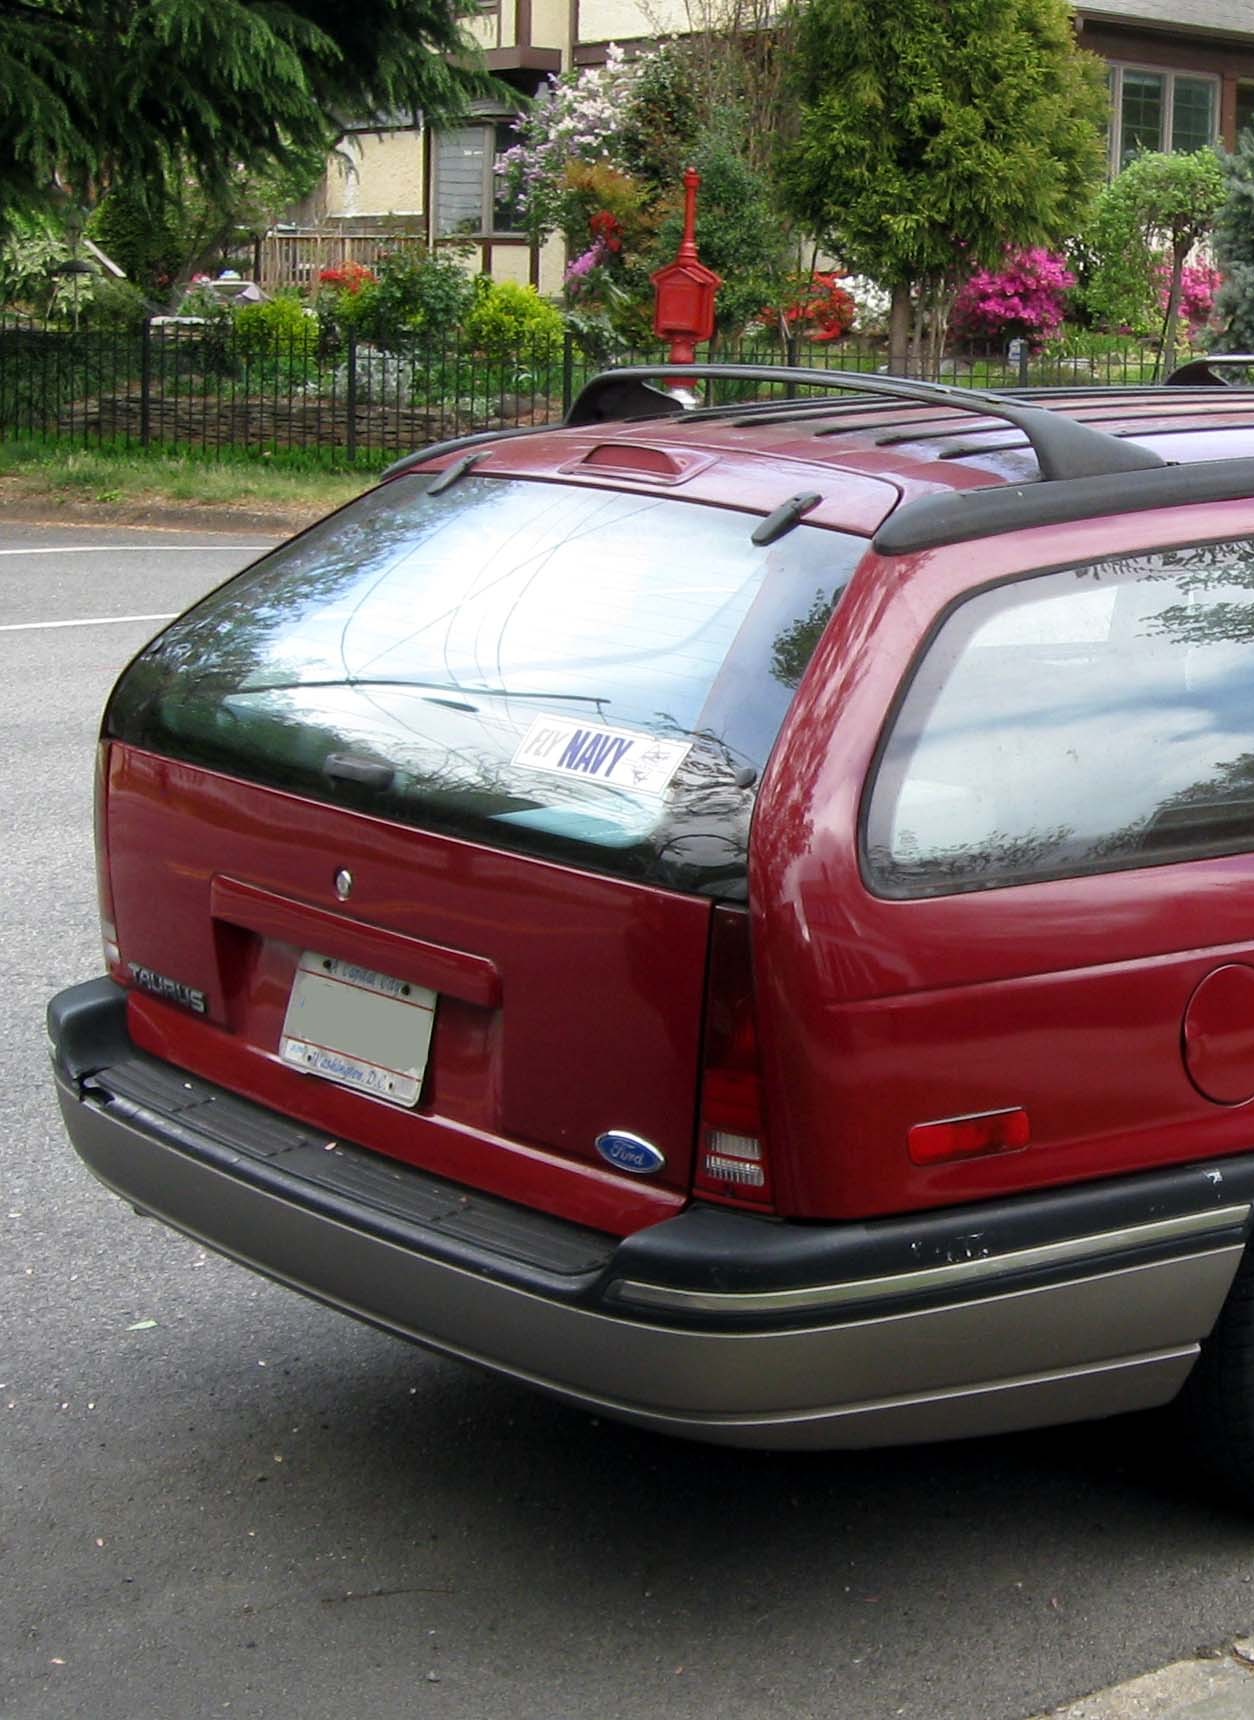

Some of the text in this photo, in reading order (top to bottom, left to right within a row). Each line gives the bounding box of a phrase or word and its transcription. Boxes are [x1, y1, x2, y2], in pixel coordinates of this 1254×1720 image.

[524, 729, 633, 777] FLY NAVY
[130, 964, 205, 1012] TAURUS
[610, 1141, 645, 1165] Ford
